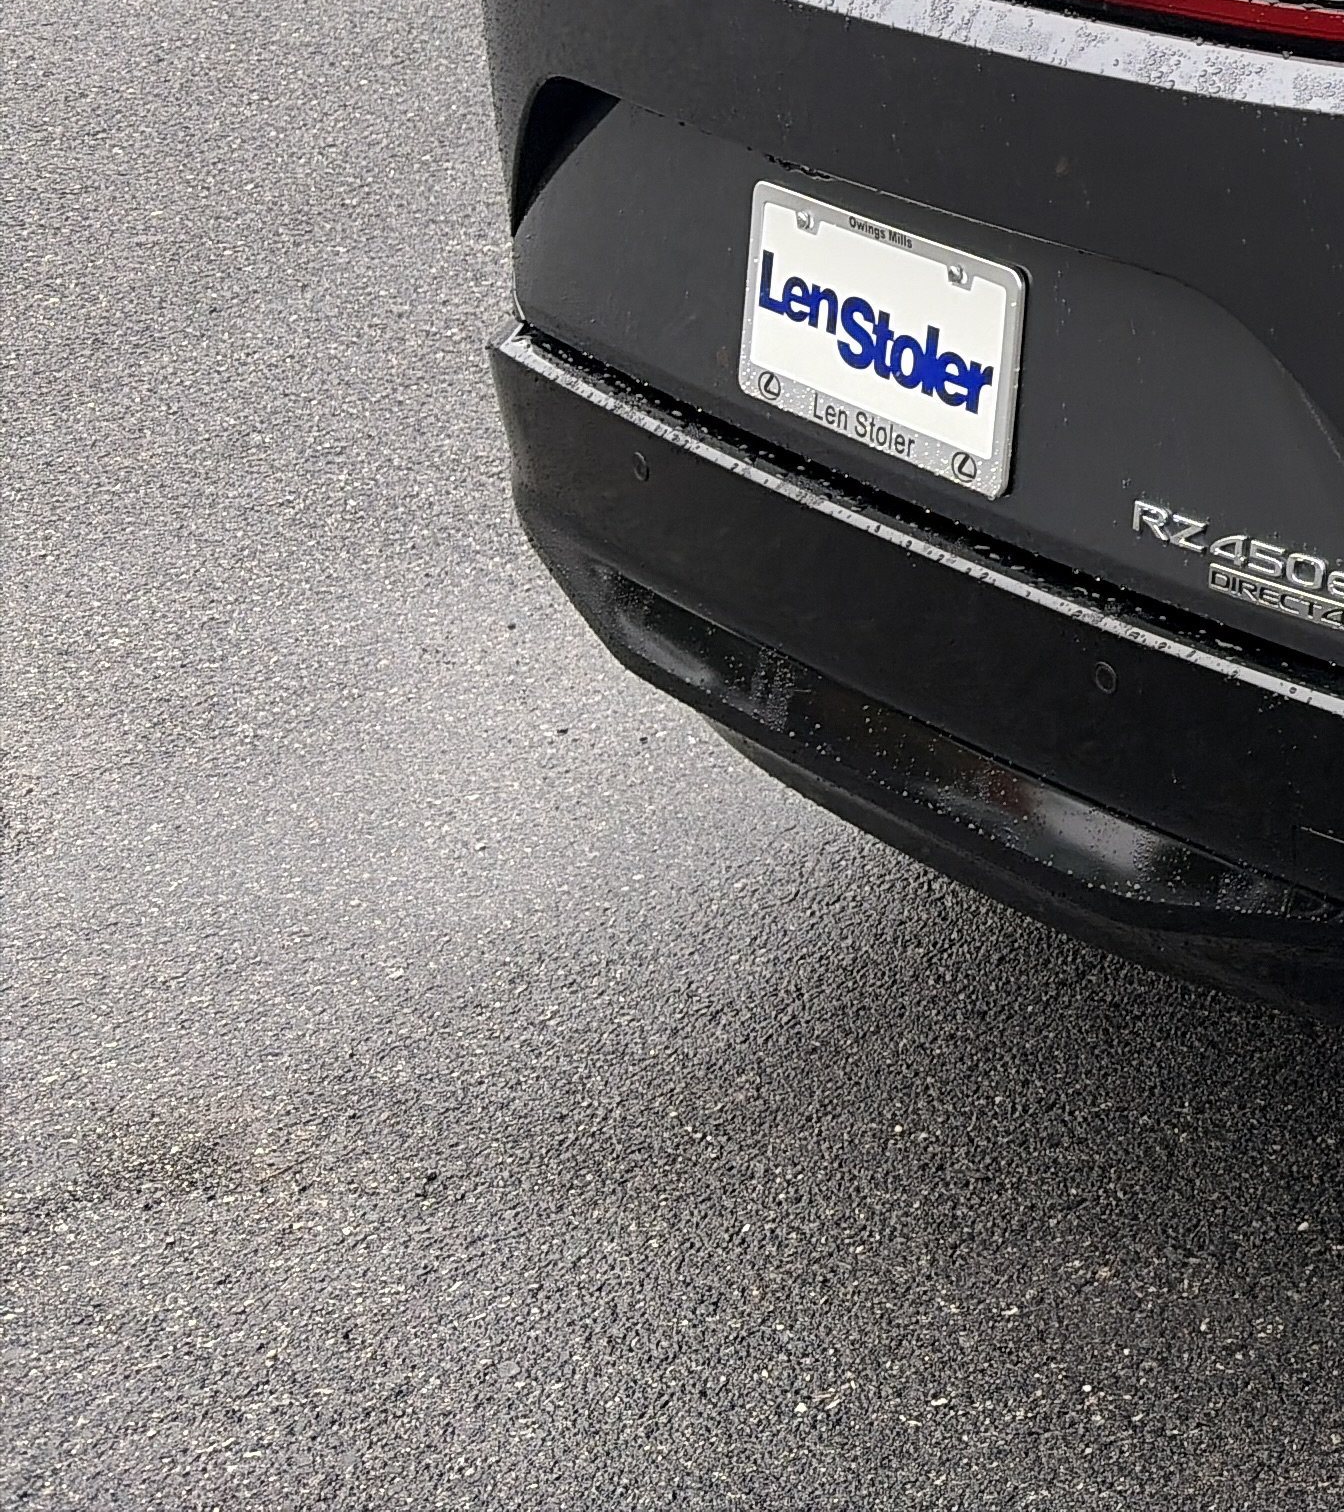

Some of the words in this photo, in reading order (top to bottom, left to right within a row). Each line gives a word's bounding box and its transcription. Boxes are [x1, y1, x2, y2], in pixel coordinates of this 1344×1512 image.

[849, 215, 887, 240] Owings
[888, 230, 913, 249] Mills
[813, 392, 848, 431] Len
[855, 410, 915, 458] Stoler
